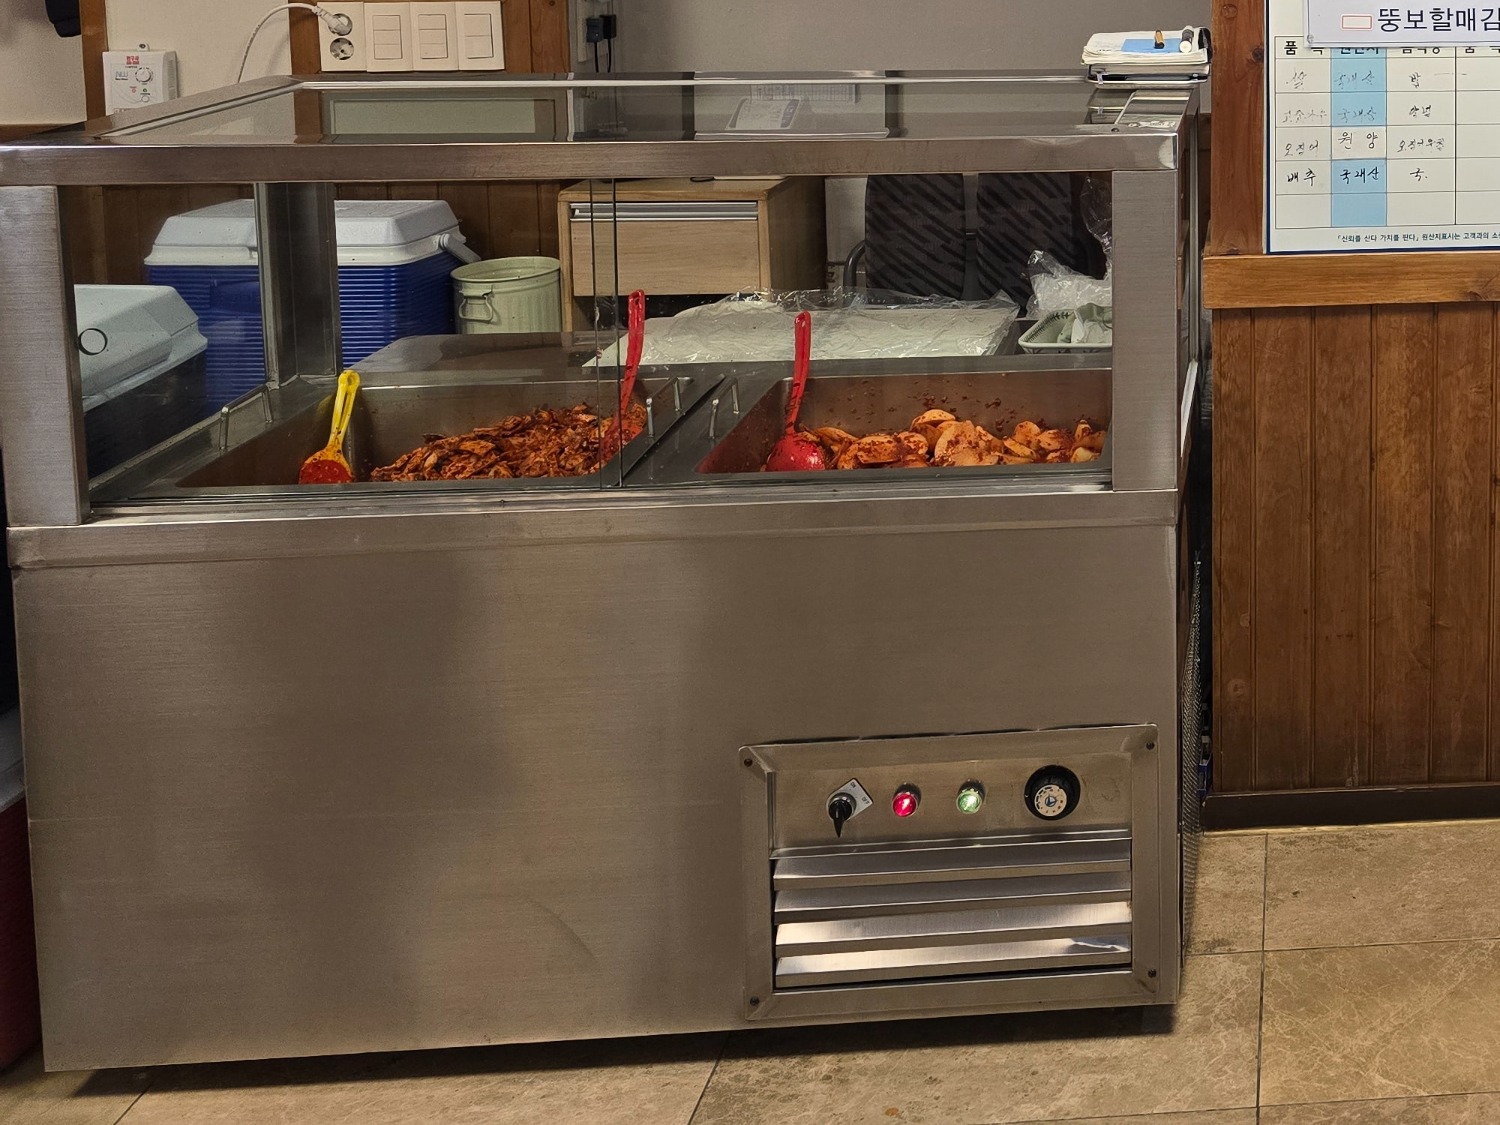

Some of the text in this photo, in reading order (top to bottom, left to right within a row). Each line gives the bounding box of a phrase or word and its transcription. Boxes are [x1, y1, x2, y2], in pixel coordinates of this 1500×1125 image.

[1287, 168, 1316, 186] 배추
[1340, 166, 1379, 184] 국내산
[1422, 233, 1460, 241] 원산지표시는
